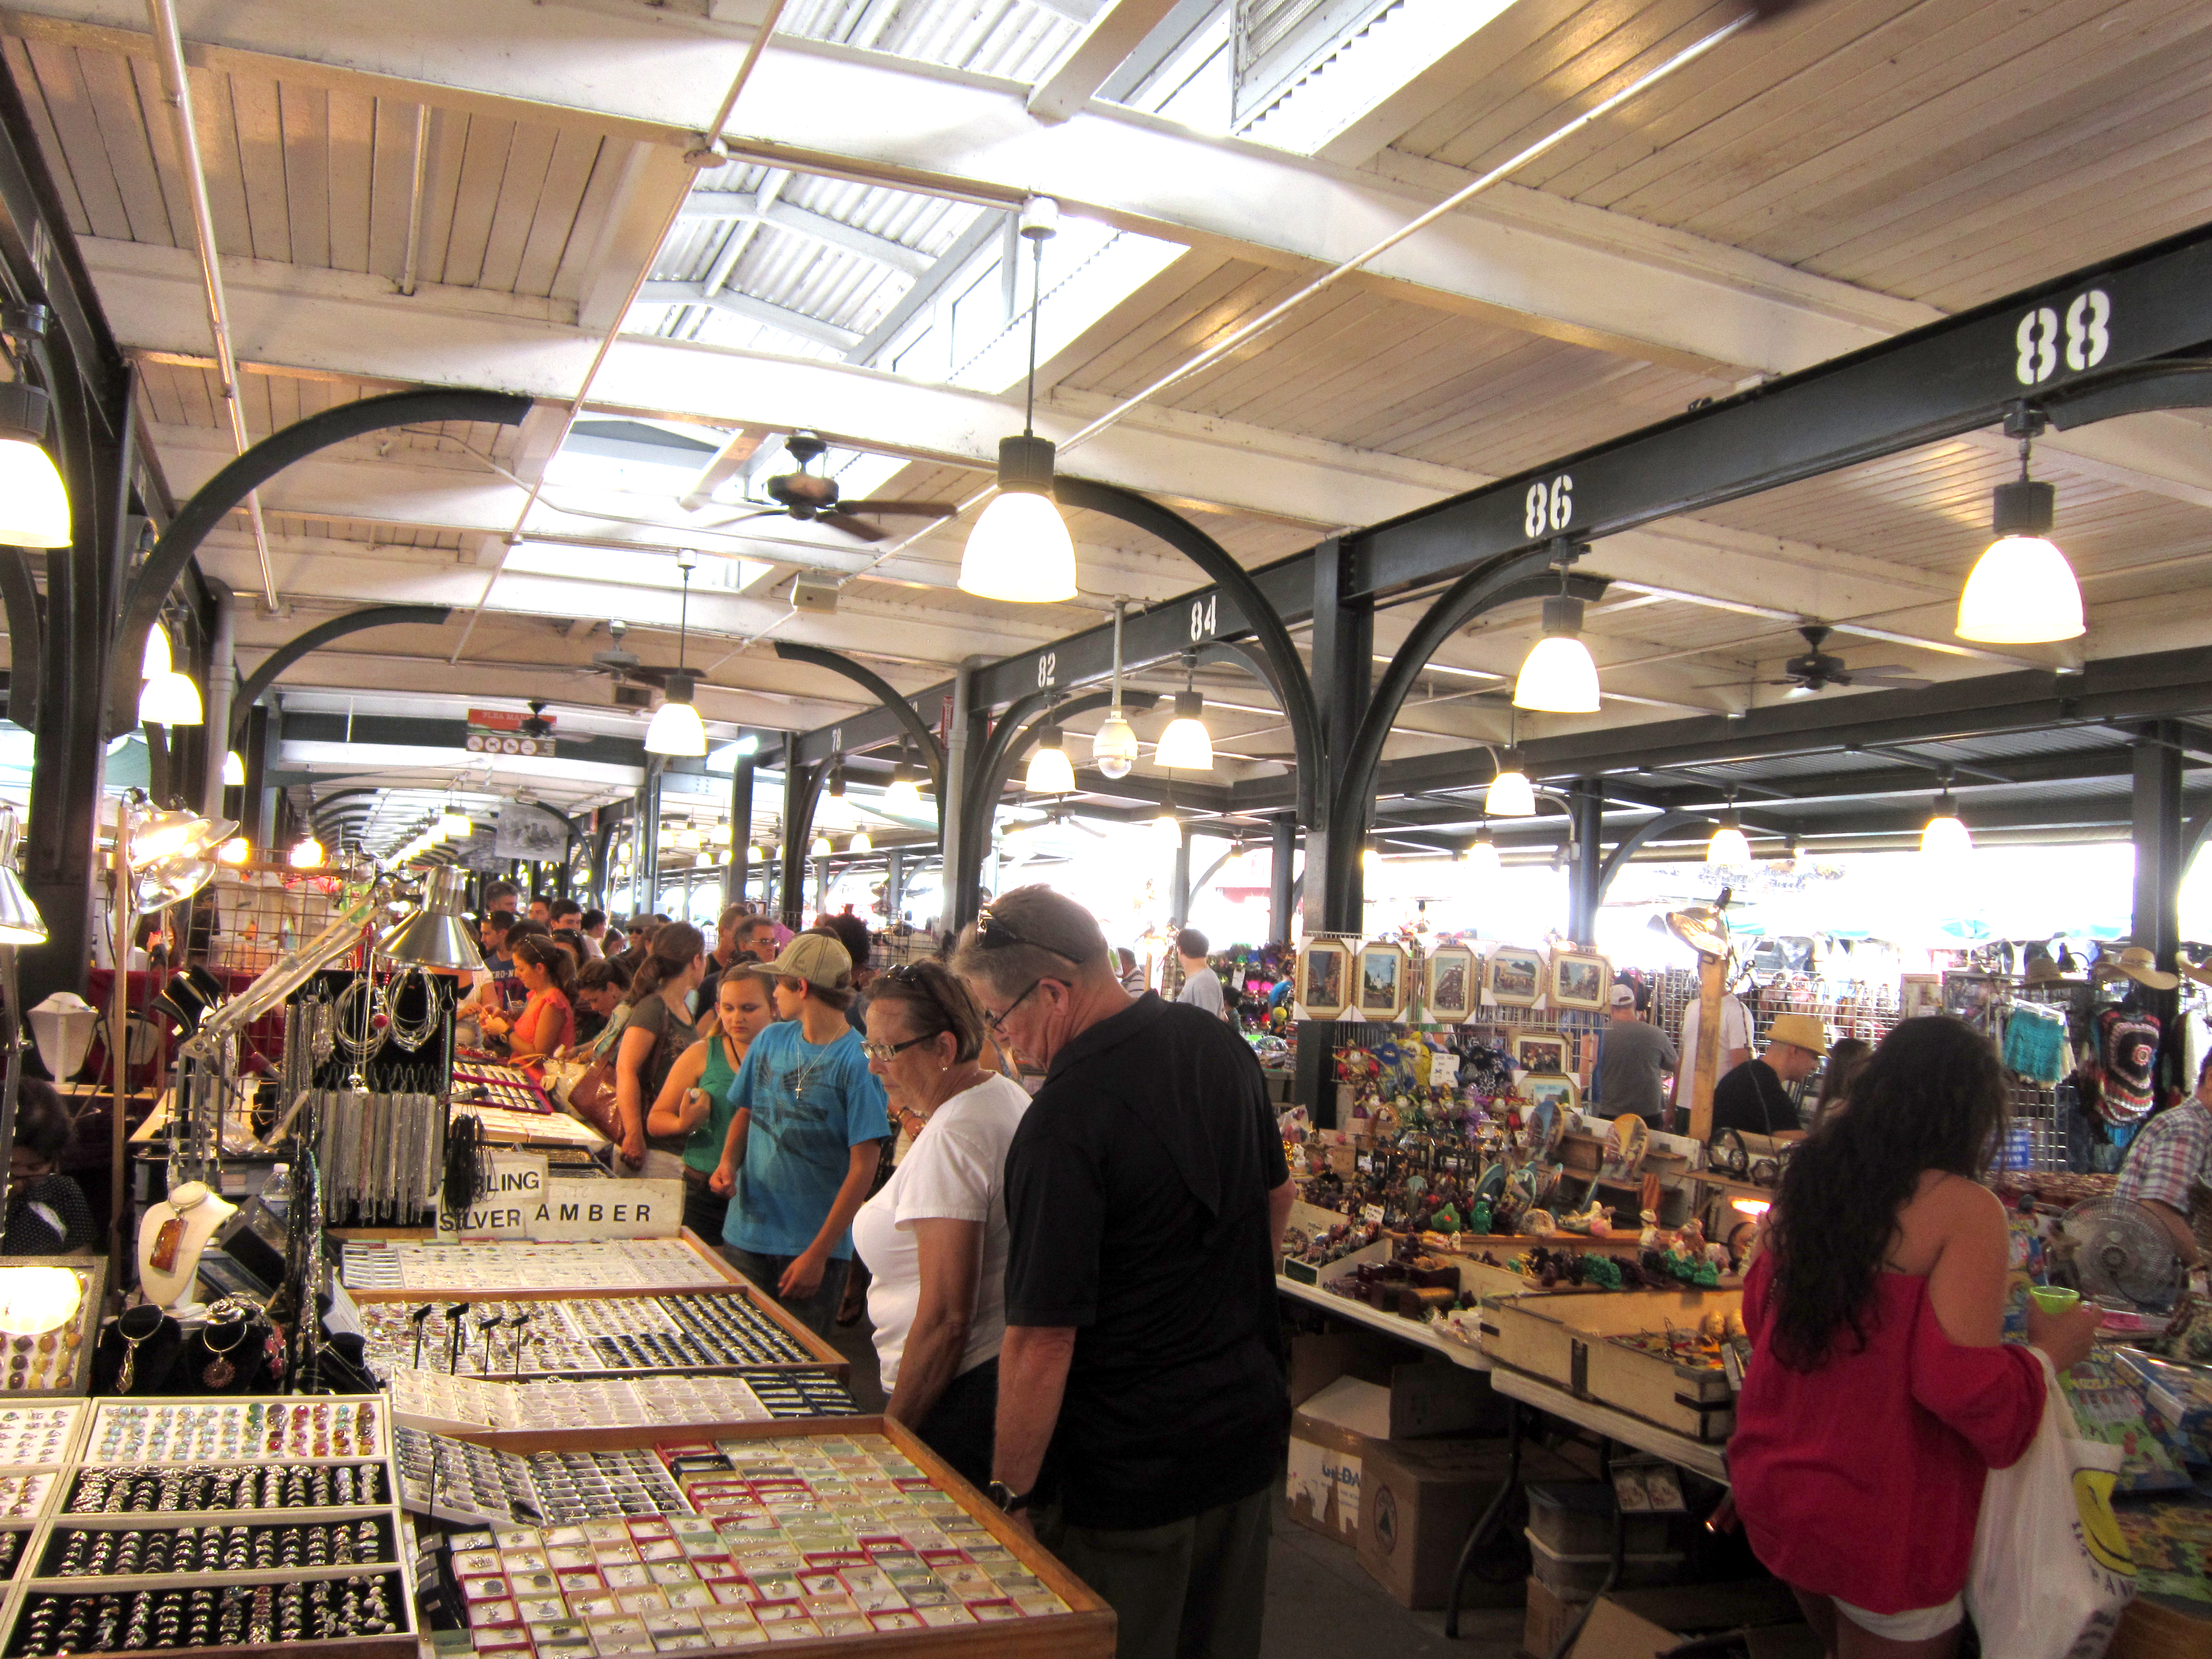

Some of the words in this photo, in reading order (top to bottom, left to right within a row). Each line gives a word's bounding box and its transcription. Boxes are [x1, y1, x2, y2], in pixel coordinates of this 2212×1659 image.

[2017, 289, 2111, 385] 88
[1525, 474, 1573, 539] 86
[1191, 595, 1216, 641] 84
[1038, 652, 1056, 688] 82
[483, 711, 504, 720] FLEA
[832, 728, 841, 752] 78
[535, 1203, 651, 1222] AMBER
